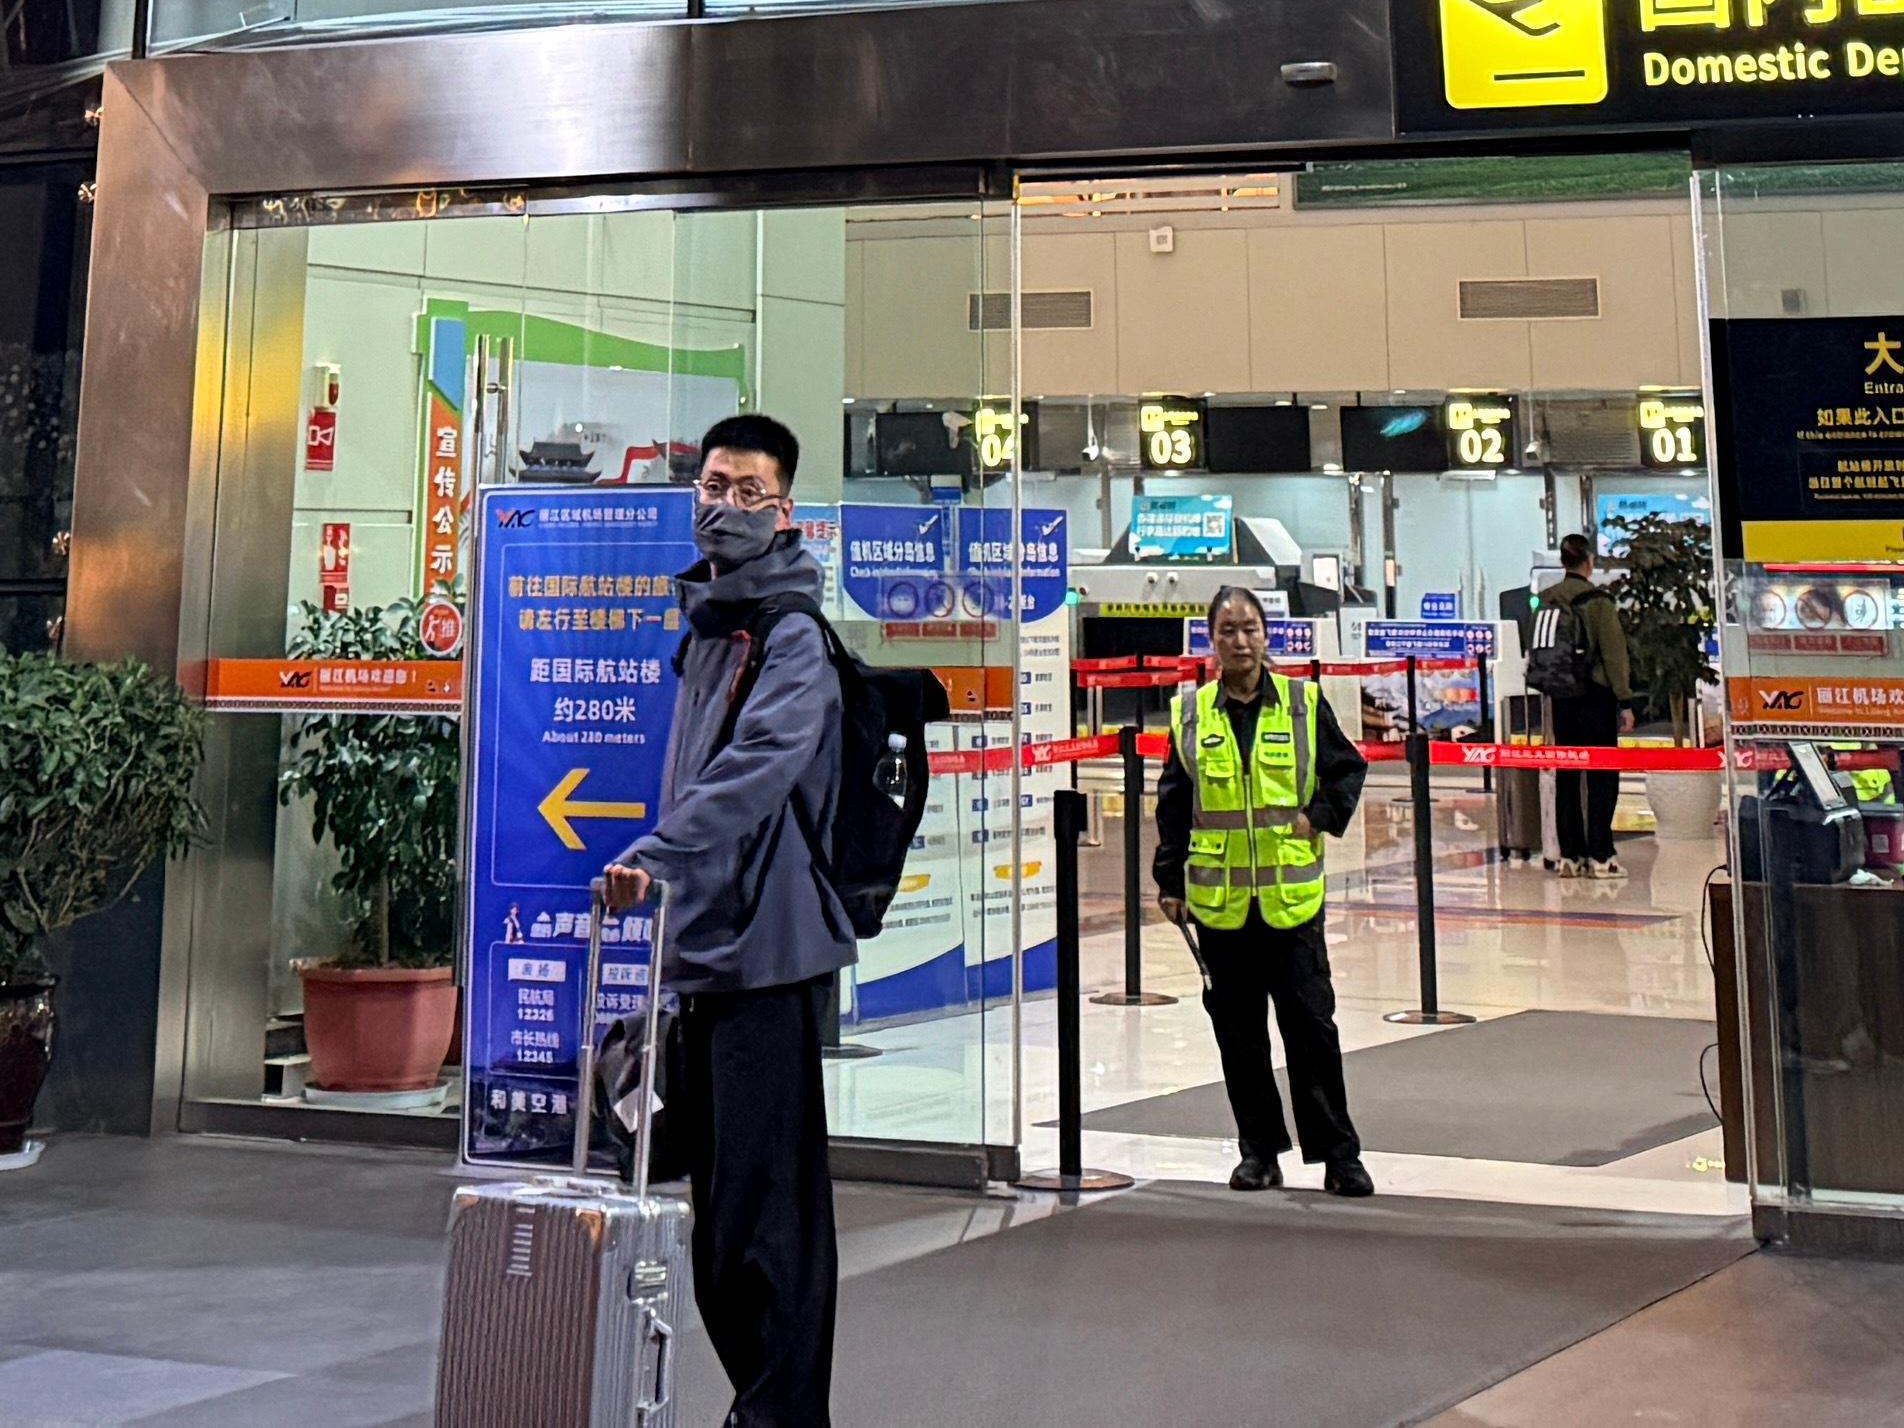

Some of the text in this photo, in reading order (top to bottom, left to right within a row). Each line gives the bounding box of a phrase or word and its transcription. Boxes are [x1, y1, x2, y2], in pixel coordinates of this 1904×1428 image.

[1641, 41, 1831, 87] Domestic
[1150, 430, 1192, 465] 03
[1460, 427, 1505, 464] 02
[1651, 426, 1697, 463] 01
[430, 426, 458, 602] 宣传公示
[508, 575, 677, 599] 前往国际航站楼的旅
[530, 657, 662, 685] 距国际航站楼
[553, 695, 636, 724] 约280米
[1758, 689, 1804, 710] YAC
